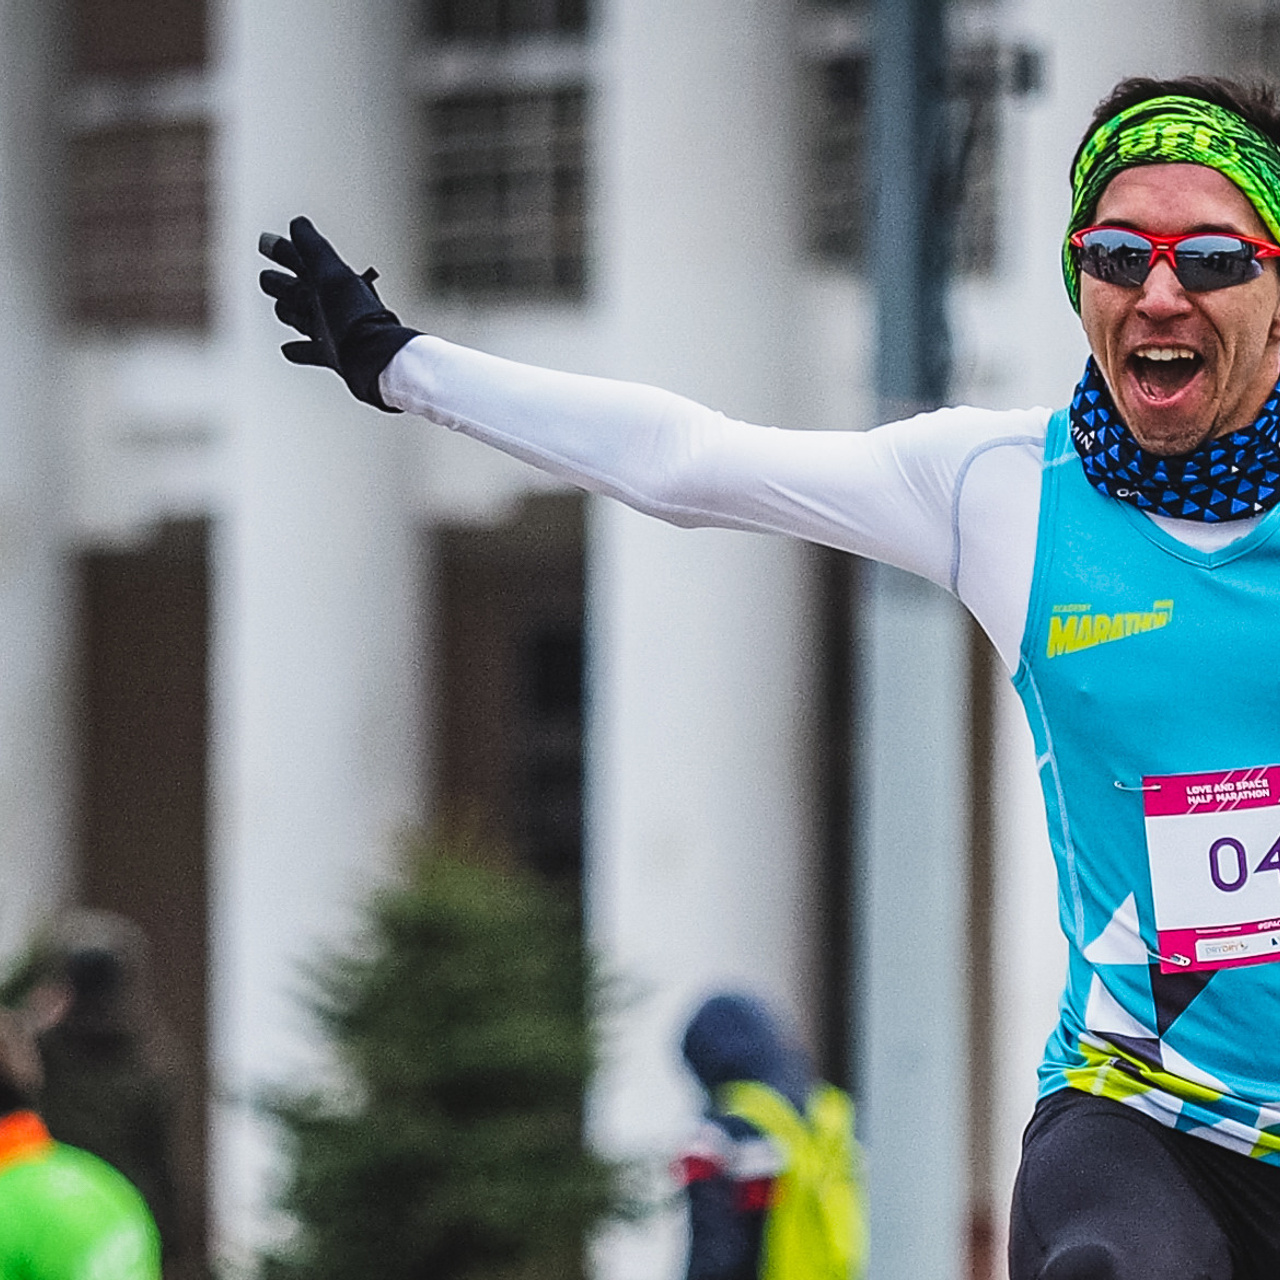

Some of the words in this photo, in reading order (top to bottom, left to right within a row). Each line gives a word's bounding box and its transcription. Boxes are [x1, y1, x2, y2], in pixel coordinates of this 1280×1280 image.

[1186, 784, 1213, 795] LOVE
[1213, 782, 1235, 793] AND
[1235, 778, 1269, 791] SPACE
[1186, 794, 1214, 805] HALF
[1215, 788, 1270, 802] MARATHON
